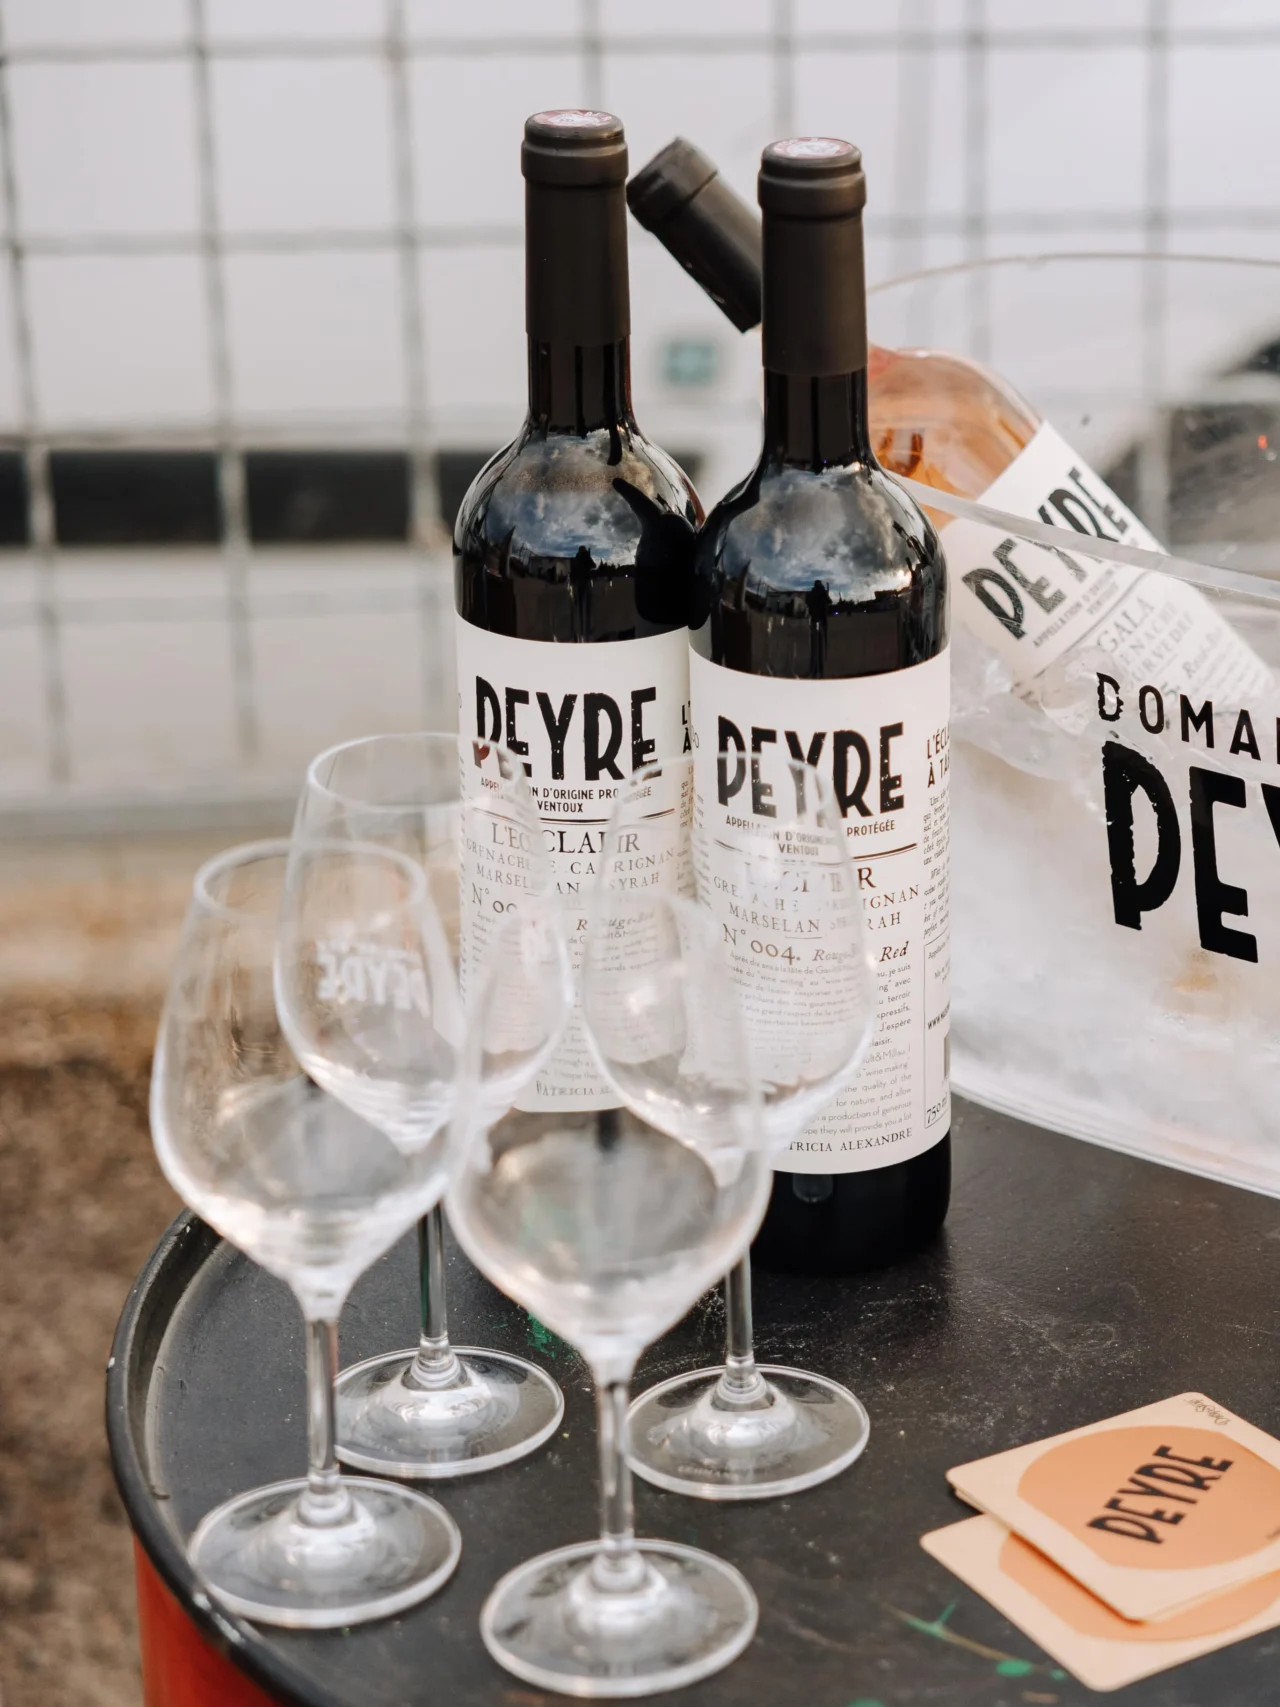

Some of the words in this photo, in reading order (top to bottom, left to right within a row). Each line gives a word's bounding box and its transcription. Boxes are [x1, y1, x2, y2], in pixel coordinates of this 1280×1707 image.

[473, 676, 662, 781] PEYRE
[717, 715, 904, 822] PEYRE
[543, 787, 594, 800] D'ORIGINE
[537, 801, 584, 813] VENTOUX
[847, 820, 895, 837] PROTÉGÉE
[729, 901, 820, 933] MARSELAN
[722, 923, 746, 946] N°
[750, 940, 801, 966] 004.
[897, 963, 911, 973] suis
[894, 977, 911, 988] avec
[887, 991, 911, 1004] terroir
[879, 1018, 912, 1032] J'espère
[870, 1037, 893, 1047] laisir.
[861, 1078, 886, 1093] quality
[889, 1076, 898, 1086] of
[901, 1072, 912, 1082] the
[836, 1098, 847, 1108] for
[879, 1089, 893, 1101] and
[895, 1087, 911, 1098] allow
[828, 1109, 871, 1123] production
[872, 1105, 880, 1117] of
[881, 1100, 912, 1118] generous
[926, 1102, 941, 1124] 750
[820, 1125, 838, 1137] they
[839, 1123, 853, 1135] will
[854, 1119, 883, 1135] provide
[884, 1117, 898, 1129] you
[903, 1111, 912, 1121] lot
[786, 1141, 833, 1153] TRICIA
[840, 1127, 912, 1152] ALEXANDRE
[1086, 1444, 1234, 1545] PEYRE
